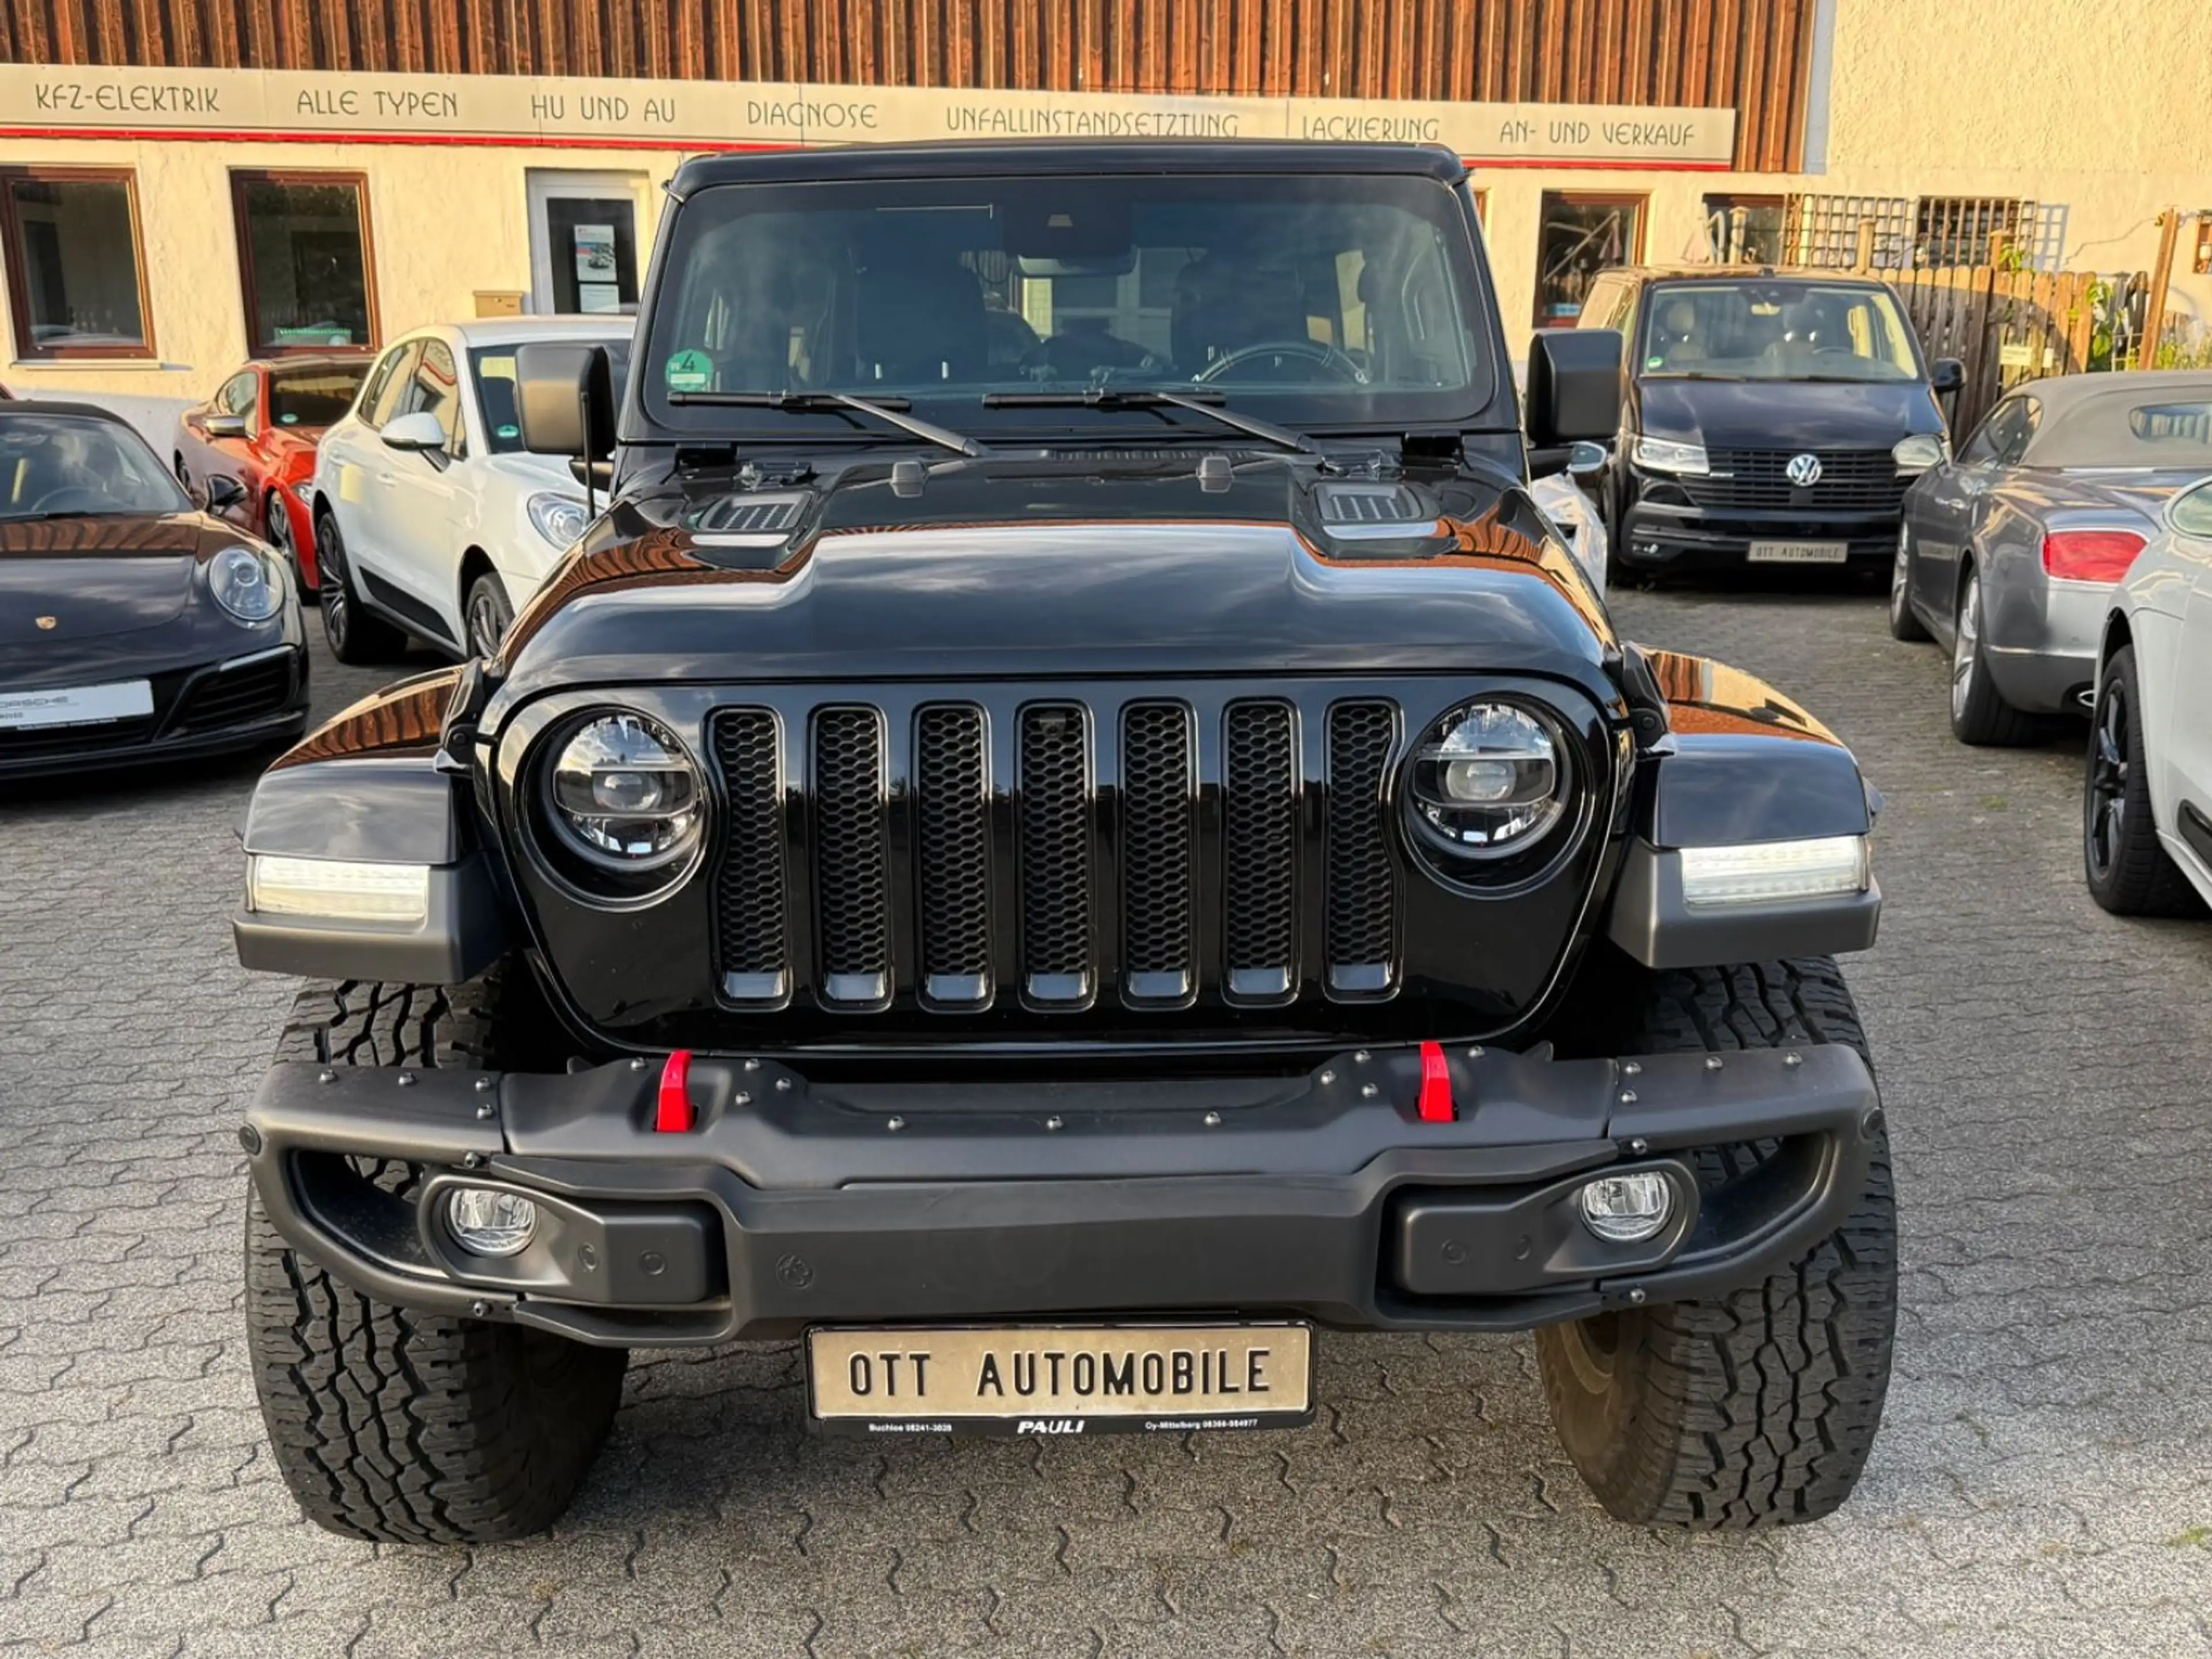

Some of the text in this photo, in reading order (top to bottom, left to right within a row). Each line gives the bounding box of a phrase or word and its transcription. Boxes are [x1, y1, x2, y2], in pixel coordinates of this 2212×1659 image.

[35, 84, 221, 112] KFZ-ELEKTRIK
[297, 89, 458, 118] ALLE TYPEN
[531, 94, 676, 123] HU UND AU
[747, 101, 878, 128] DIAGNOSE
[946, 107, 1238, 137] UNFALLINSTANDSETZTUNG
[1302, 115, 1440, 141] LACKIERUNG
[1499, 120, 1695, 146] AN- UND VERKAUF
[1757, 547, 1774, 557] OTT
[849, 1350, 1270, 1396] OTT AUTOMOBILE
[1017, 1420, 1085, 1434] PAULI
